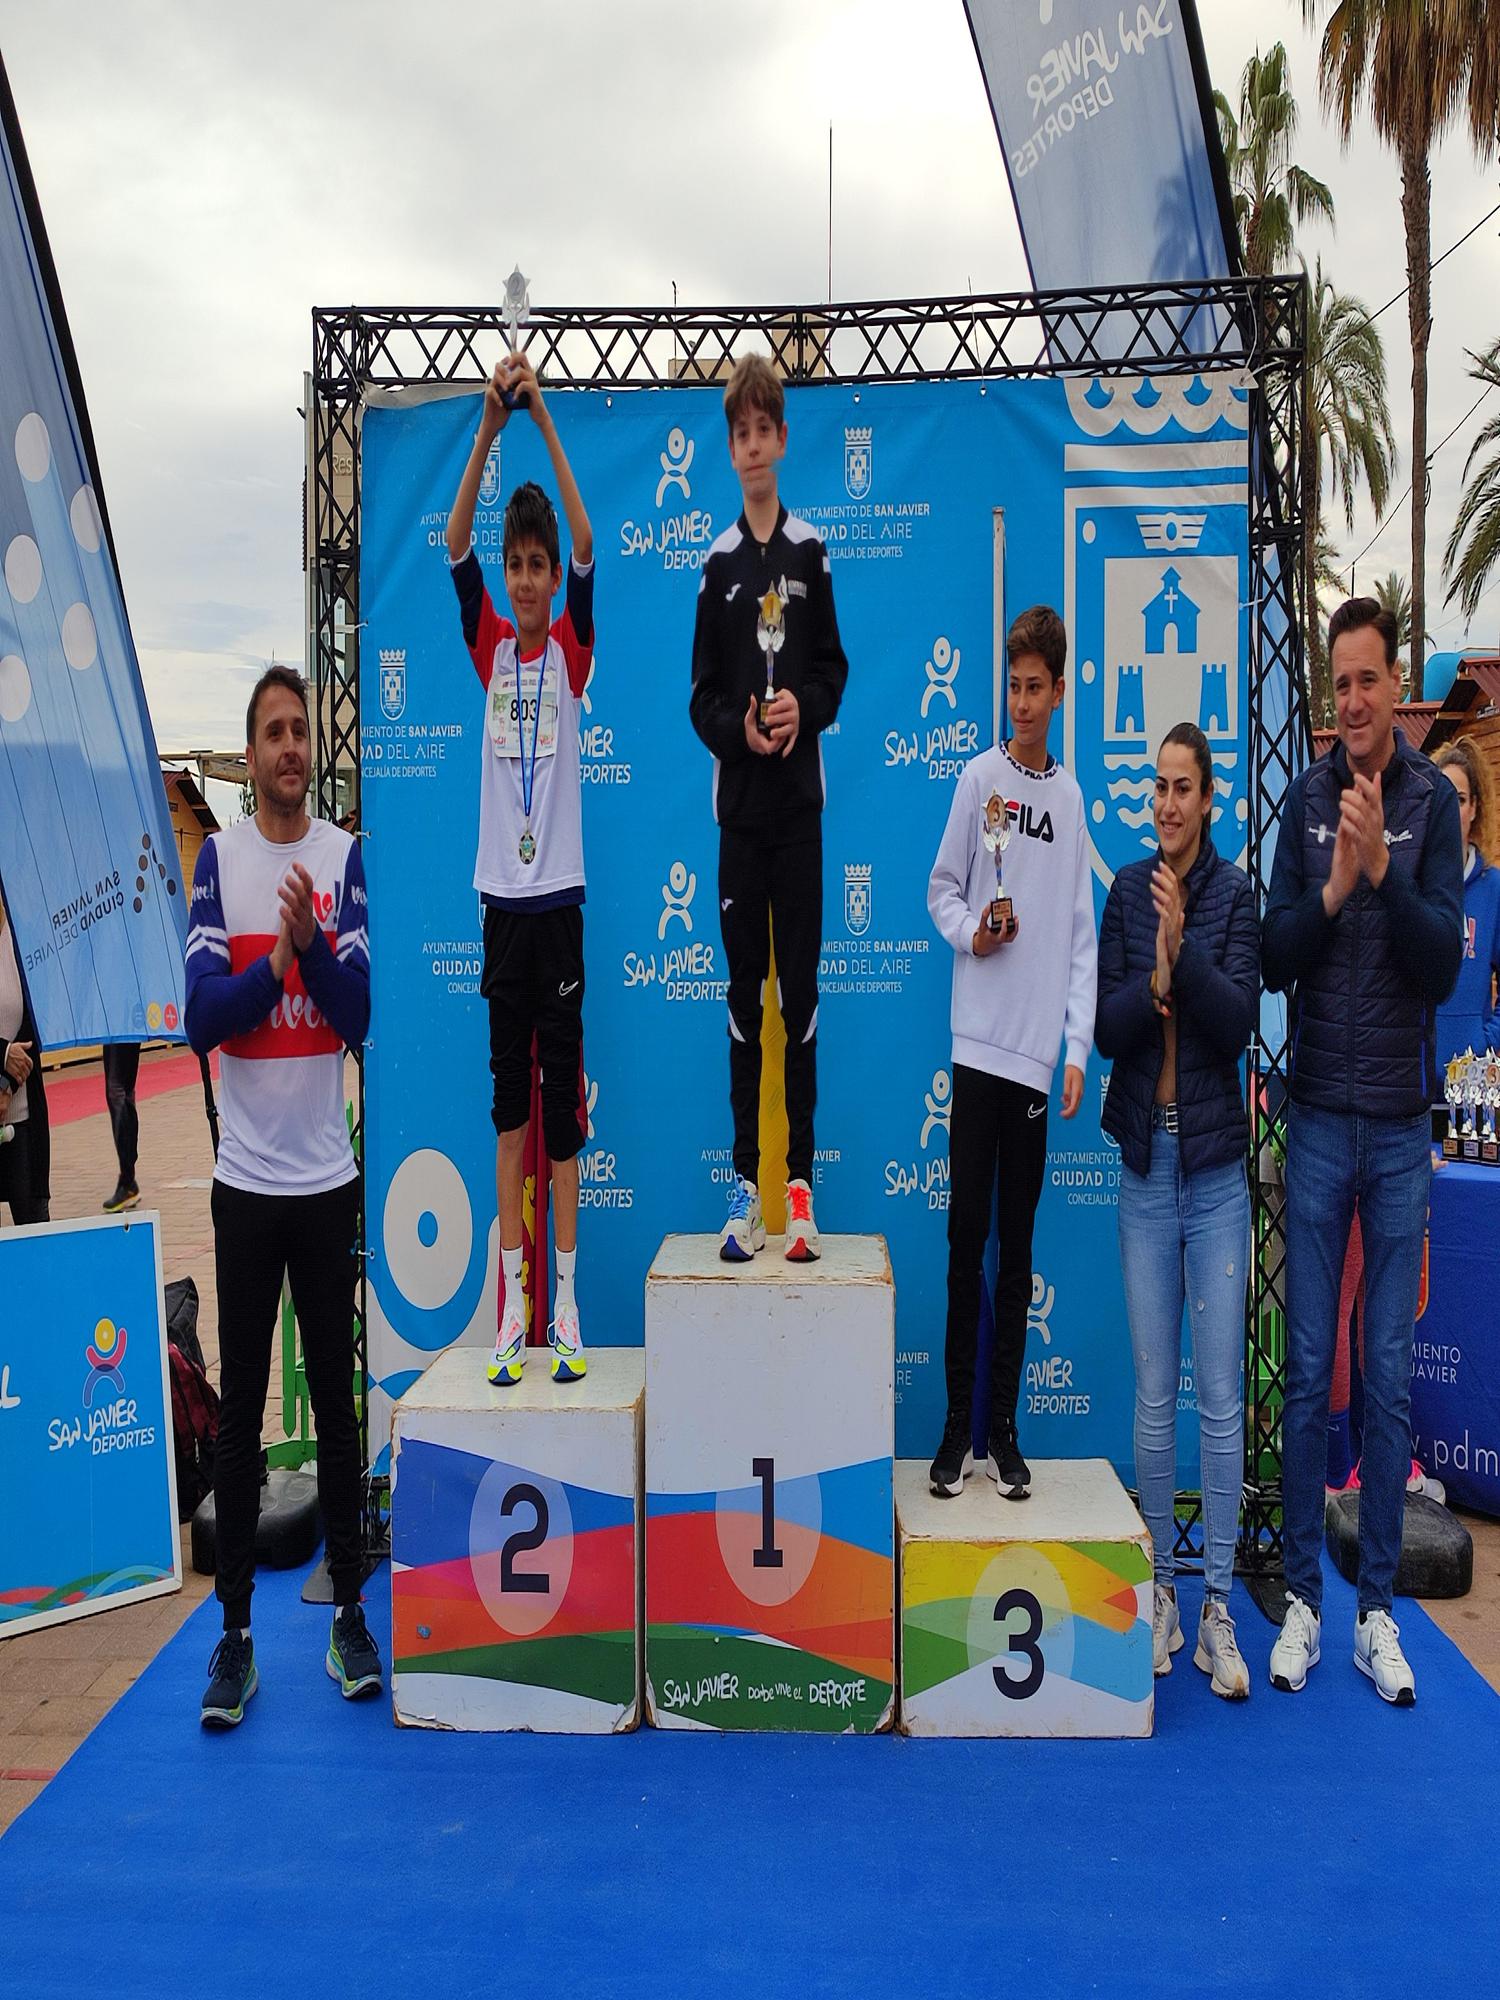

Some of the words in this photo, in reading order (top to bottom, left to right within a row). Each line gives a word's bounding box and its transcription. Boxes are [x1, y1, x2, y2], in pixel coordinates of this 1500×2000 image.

[859, 504, 872, 518] DE
[874, 504, 894, 517] SAN
[895, 503, 930, 517] JAVIER
[620, 520, 654, 557] SAN
[655, 509, 713, 553] JAVIER
[851, 523, 876, 541] DEL
[880, 522, 913, 540] AIRE
[856, 547, 867, 559] DE
[867, 545, 904, 559] DEPORTES
[510, 698, 538, 721] 803
[395, 725, 407, 738] DE
[408, 725, 428, 737] SAN
[429, 725, 463, 737] JAVIER
[387, 744, 410, 760] DEL
[414, 743, 446, 759] AIRE
[884, 731, 918, 767] SAN
[920, 720, 979, 763] JAVIER
[391, 766, 402, 778] DE
[402, 765, 437, 777] DEPORTES
[928, 760, 968, 780] DEPO
[1005, 800, 1055, 844] FILA
[422, 942, 485, 954] AYUNTAMIENT
[860, 941, 872, 953] DE
[873, 940, 893, 953] SAN
[895, 940, 929, 952] JAVIER
[432, 960, 482, 975] CIUDAD
[623, 952, 656, 987] SAN
[658, 942, 714, 984] JAVIER
[820, 959, 847, 975] DAD
[851, 959, 875, 975] DEL
[880, 958, 912, 974] AIRE
[856, 981, 867, 993] DE
[867, 981, 903, 993] DEPORTES
[813, 1150, 841, 1162] AVIER
[884, 1161, 918, 1196] SAN
[920, 1155, 951, 1193] JAV
[1052, 1171, 1103, 1187] CIUDAD
[578, 1189, 634, 1208] EPORTES
[1067, 1191, 1112, 1206] CONCEJALÍA
[896, 1351, 930, 1364] JAVIER
[896, 1370, 913, 1386] RE
[1026, 1356, 1073, 1392] AVIER
[1411, 1361, 1457, 1385] JAVIER
[48, 1417, 81, 1451] SAN
[83, 1398, 137, 1442] JAVIER
[92, 1426, 155, 1456] DEPORTES
[752, 1457, 784, 1568] 1
[501, 1483, 550, 1594] 2
[992, 1588, 1044, 1700] 3
[664, 1679, 690, 1709] SAN
[693, 1673, 739, 1707] JAVIER
[809, 1679, 867, 1711] DEPORTE
